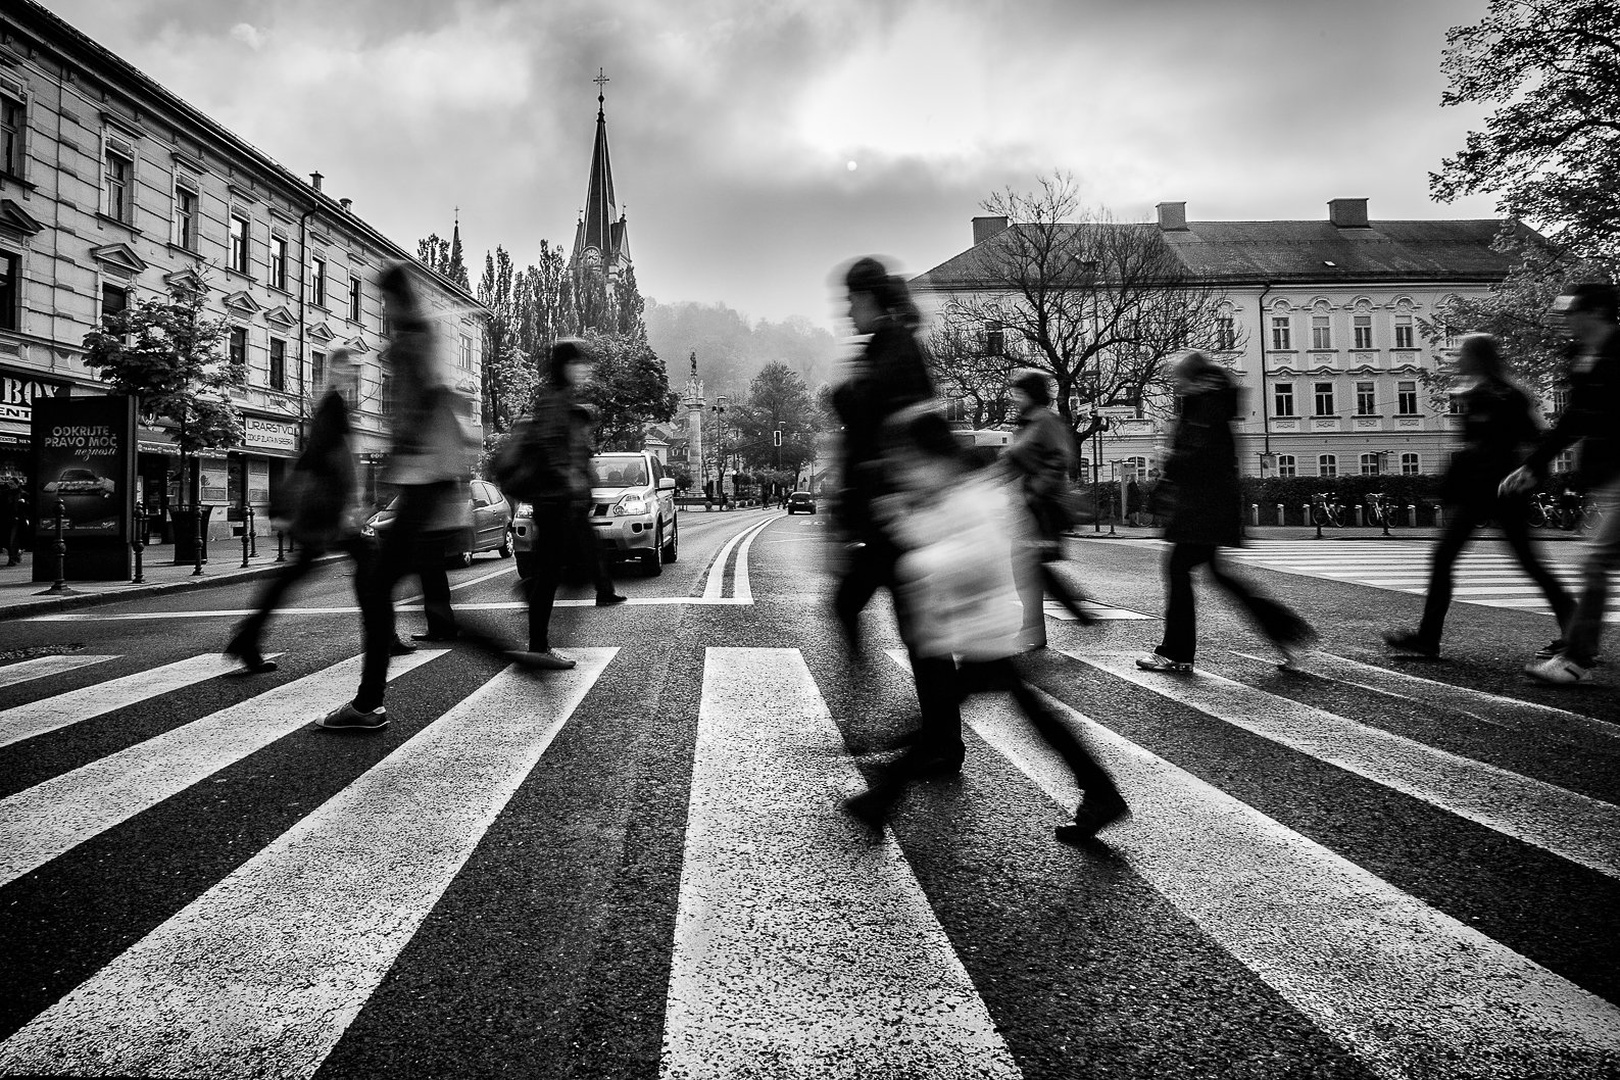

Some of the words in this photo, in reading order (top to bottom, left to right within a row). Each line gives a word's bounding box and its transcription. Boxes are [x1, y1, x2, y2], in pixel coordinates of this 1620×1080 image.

[52, 426, 109, 437] ODKRIJTE
[45, 437, 85, 448] PRAVO
[88, 433, 117, 447] MOČ
